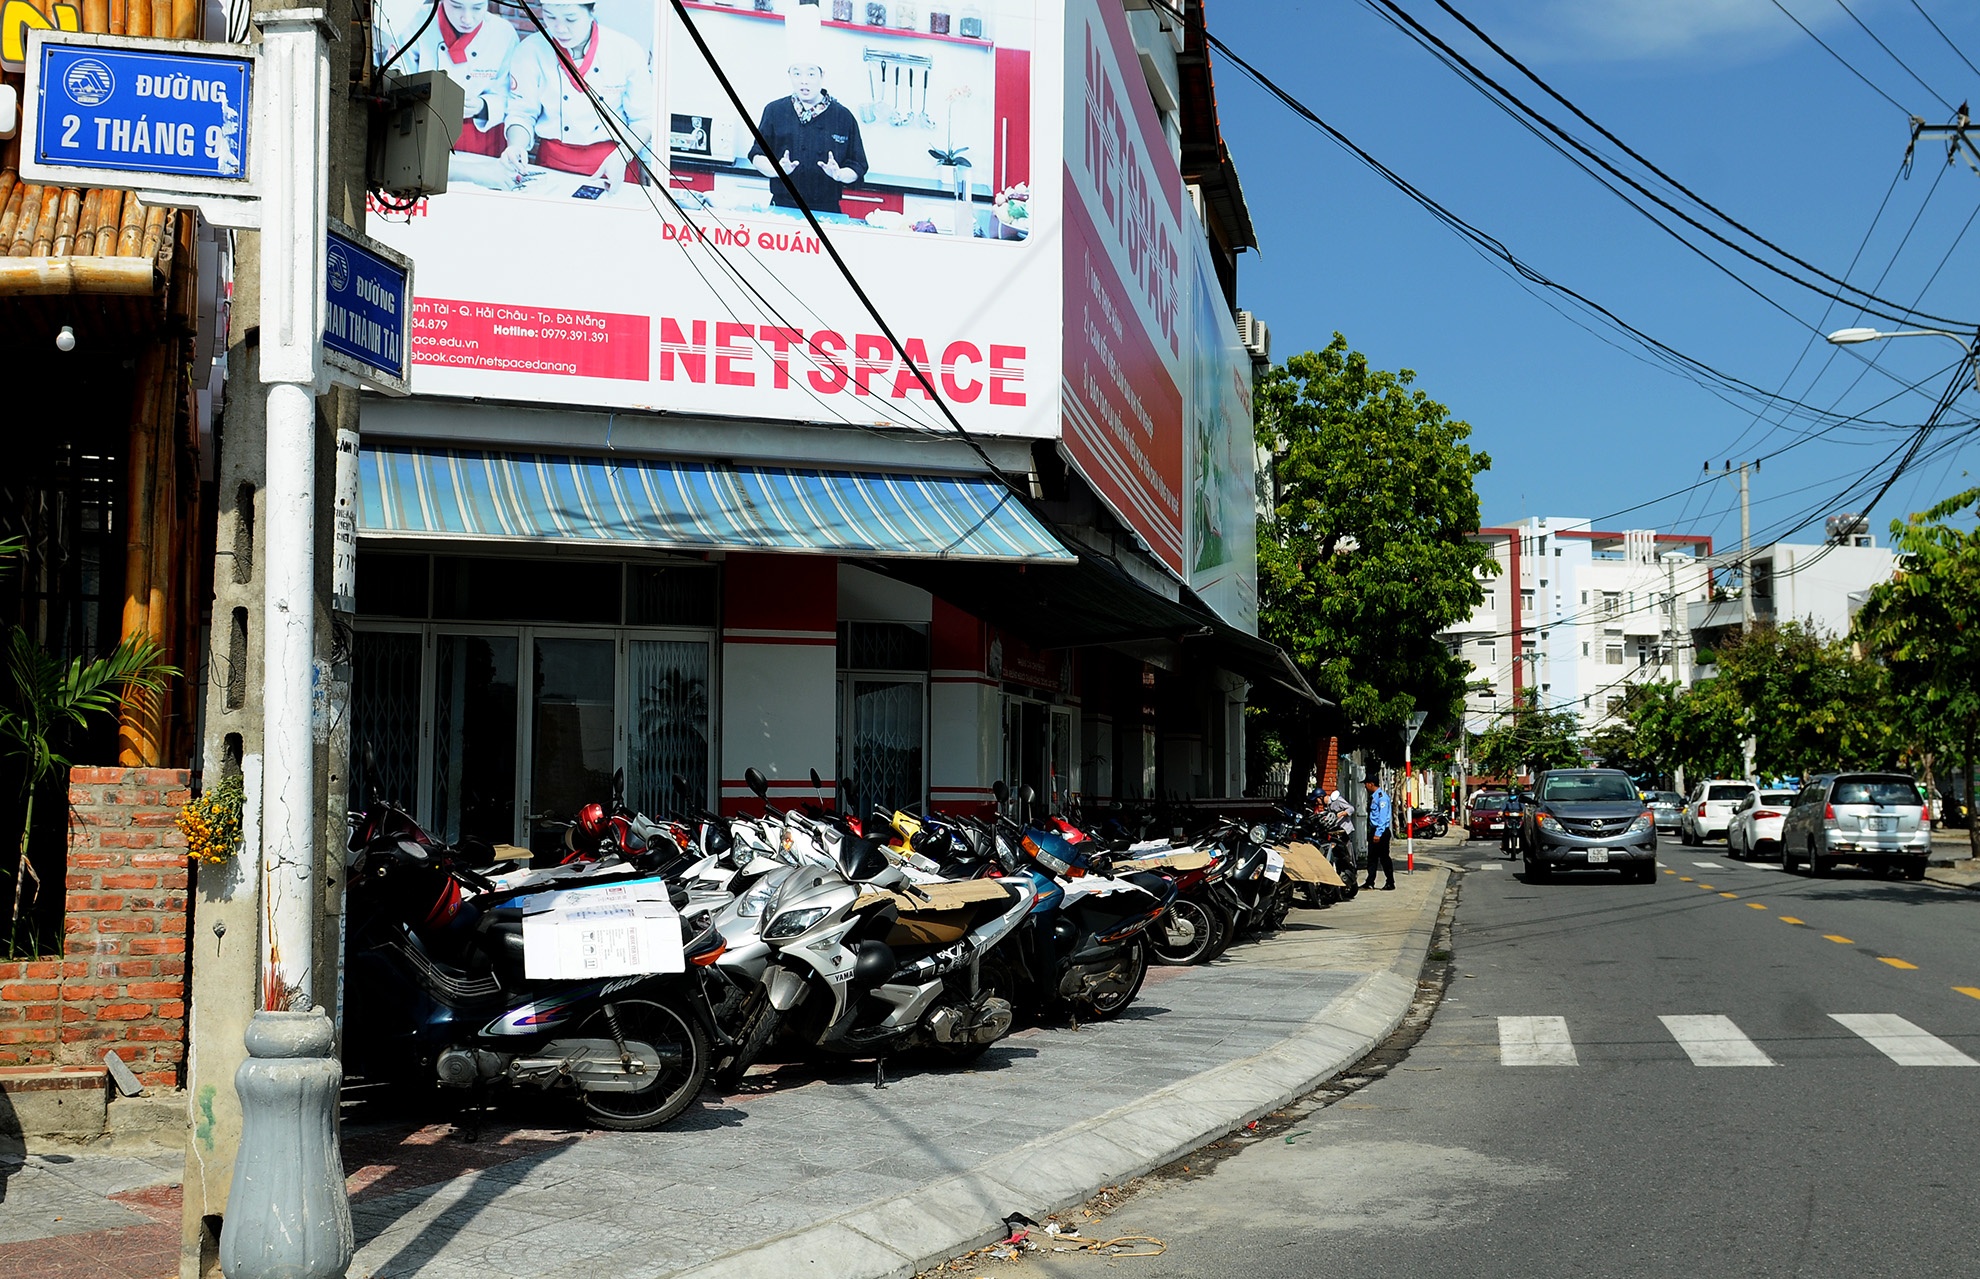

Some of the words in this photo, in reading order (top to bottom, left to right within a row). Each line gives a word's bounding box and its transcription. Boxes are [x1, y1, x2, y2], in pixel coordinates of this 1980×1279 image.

[136, 72, 227, 103] ĐƯỜNG
[61, 115, 81, 149] 2
[94, 114, 195, 157] THÁNG
[204, 125, 223, 159] 9
[1085, 17, 1179, 361] NETSPACE
[662, 223, 704, 247] DẠY
[715, 224, 750, 247] MỞ
[757, 230, 820, 254] QUÁN
[356, 275, 395, 314] ĐƯỜNG
[433, 303, 449, 315] Tài
[459, 305, 472, 318] Q.
[476, 306, 494, 319] Hải
[497, 308, 528, 321] Châu
[537, 311, 553, 326] Tp.
[556, 314, 573, 325] Đà
[576, 314, 606, 329] Nẵng
[349, 310, 381, 355] THÀNH
[383, 323, 399, 364] TÀI
[412, 336, 479, 349] ace.edu.vn
[494, 324, 539, 338] Hotline:
[541, 327, 609, 343] 0979.391.391
[660, 317, 1026, 407] NETSPACE
[835, 970, 854, 982] YAMA
